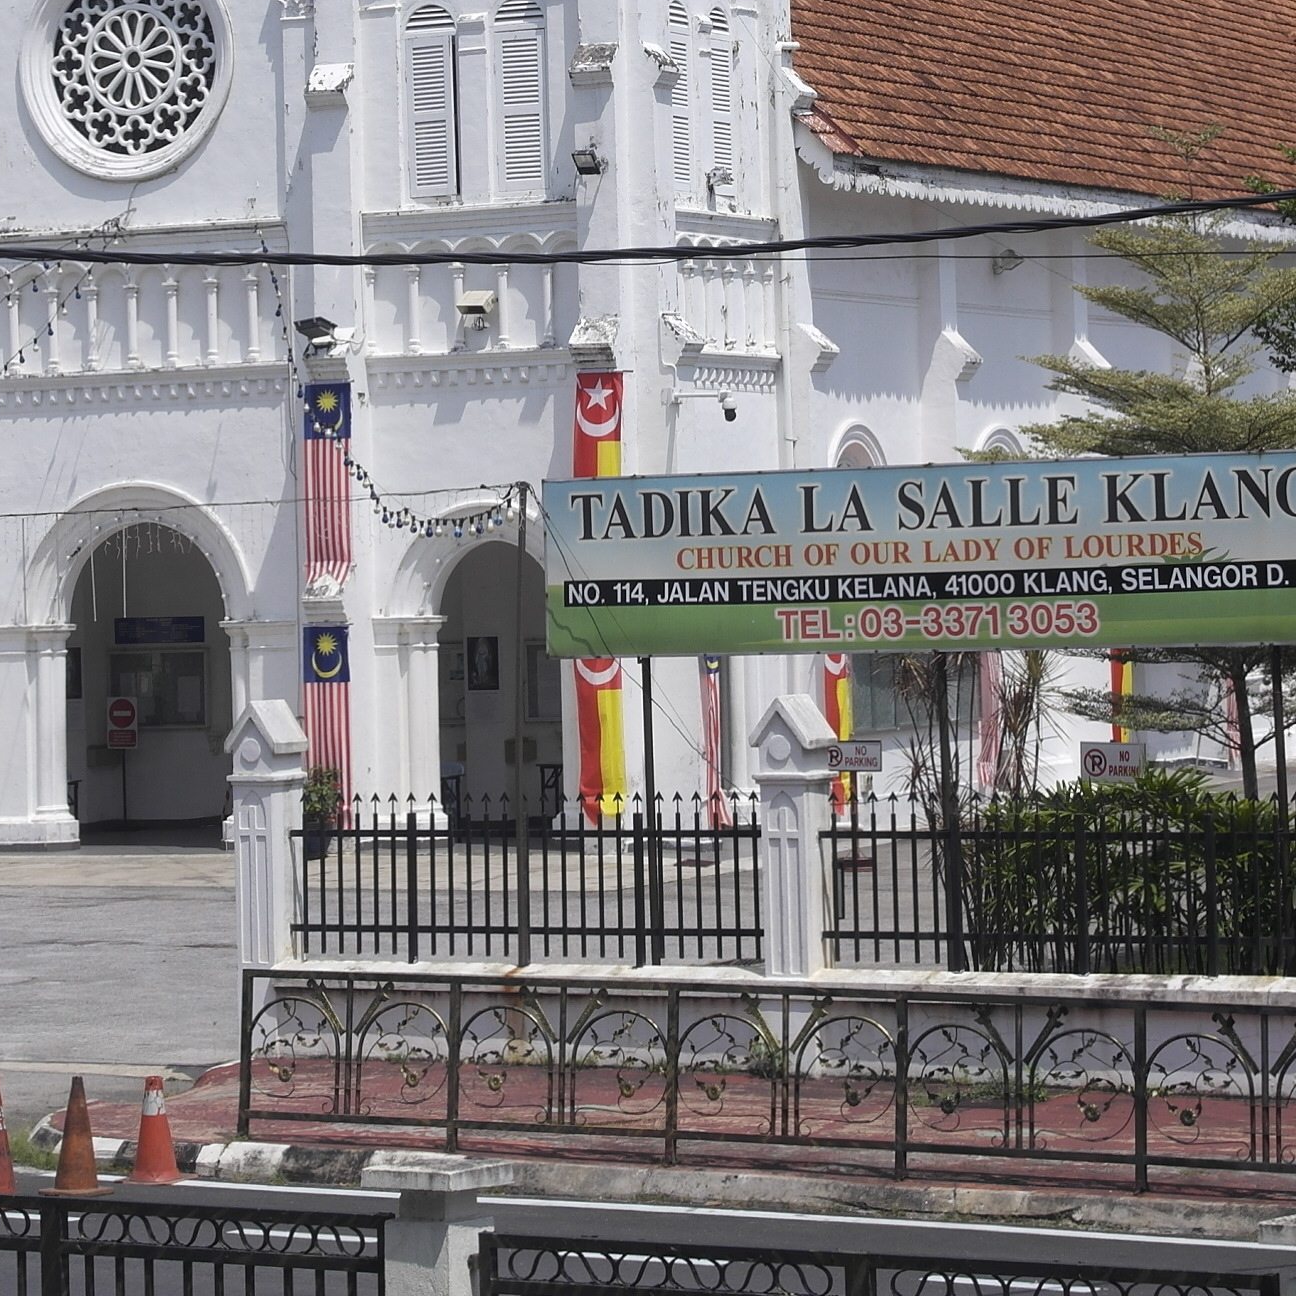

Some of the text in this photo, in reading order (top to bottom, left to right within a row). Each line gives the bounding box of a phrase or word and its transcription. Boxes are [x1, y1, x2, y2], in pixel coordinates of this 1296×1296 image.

[571, 487, 777, 541] TADIKA
[799, 484, 874, 533] LA
[898, 475, 1079, 531] SALLE
[676, 531, 1204, 571] CHURCH OF OUR LADY OF LOURDES
[568, 582, 605, 605] NO.
[612, 582, 649, 607] 114,
[657, 580, 730, 604] JALAN
[737, 578, 834, 602] TENGKU
[837, 575, 937, 601] KELANA,
[944, 573, 1016, 597] 41000
[1023, 569, 1113, 596] KLANG,
[1121, 564, 1258, 592] SELANGOR
[1267, 562, 1289, 587] D.
[845, 757, 878, 767] PARKING
[855, 746, 867, 756] NO
[1119, 751, 1130, 762] NO
